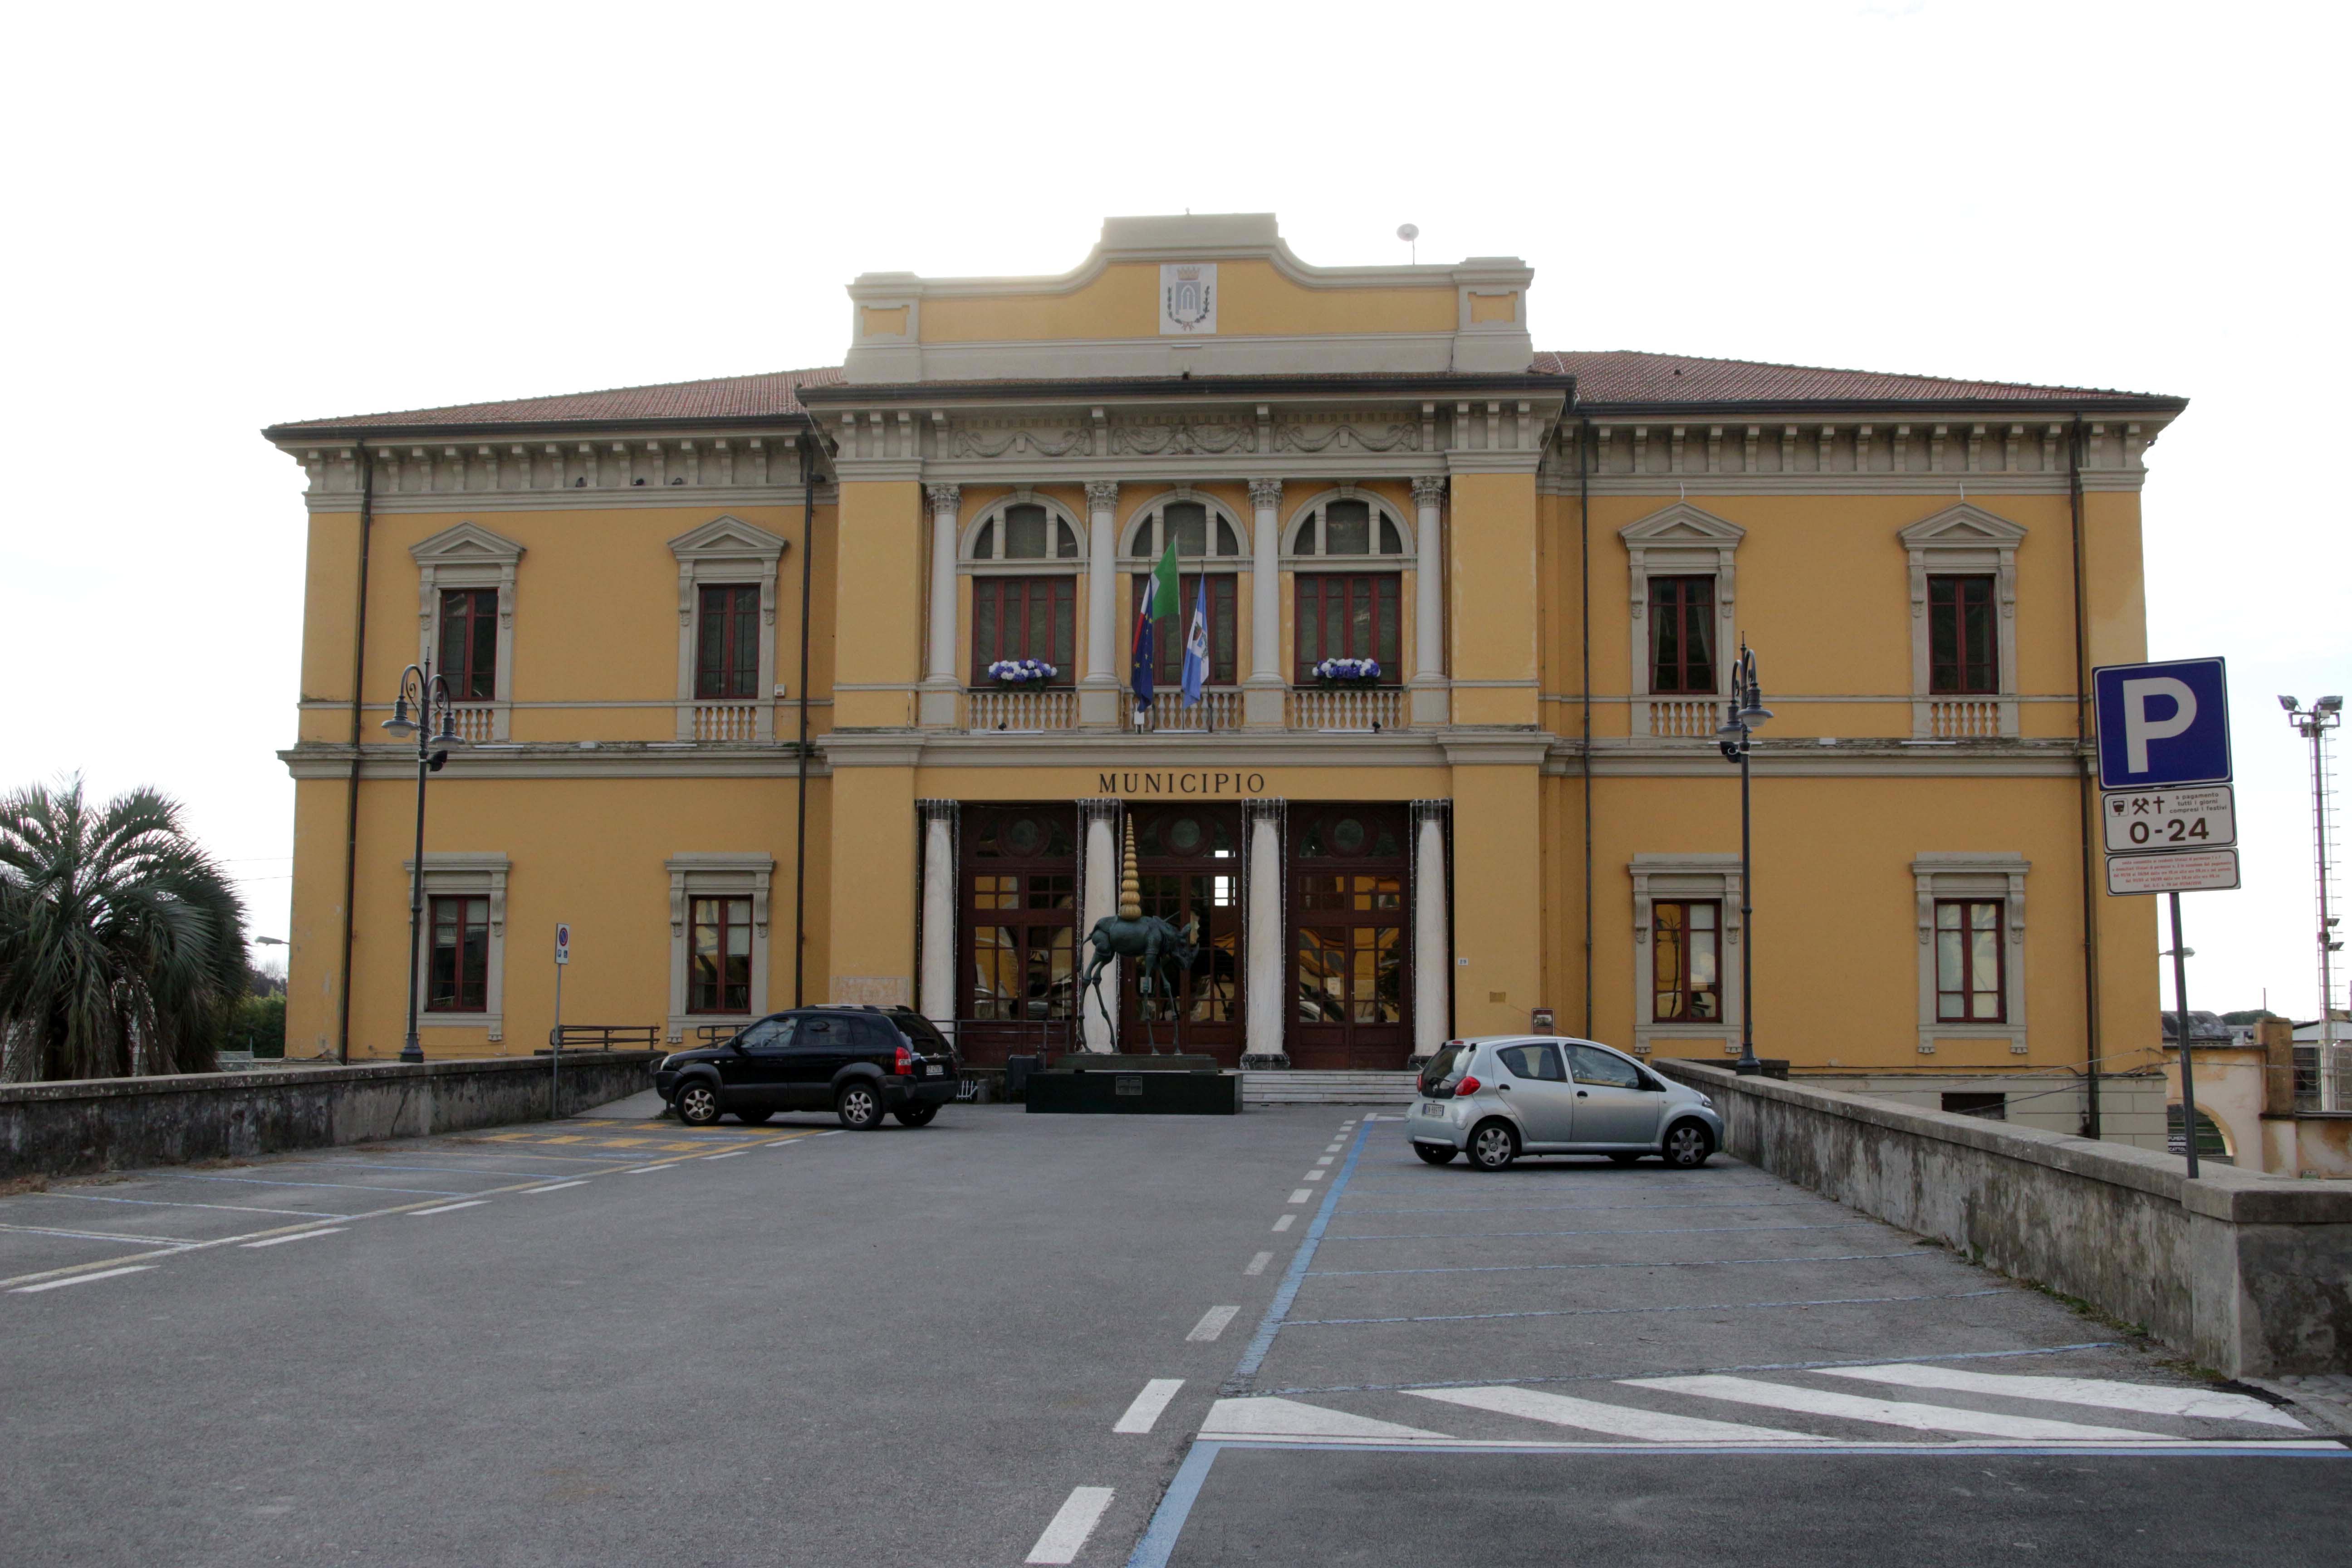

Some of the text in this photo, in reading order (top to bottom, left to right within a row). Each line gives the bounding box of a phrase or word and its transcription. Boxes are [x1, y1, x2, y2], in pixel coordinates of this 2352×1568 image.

[2123, 676, 2197, 774] P
[1099, 773, 1264, 793] MUNICIPIO
[2170, 804, 2199, 814] compresi
